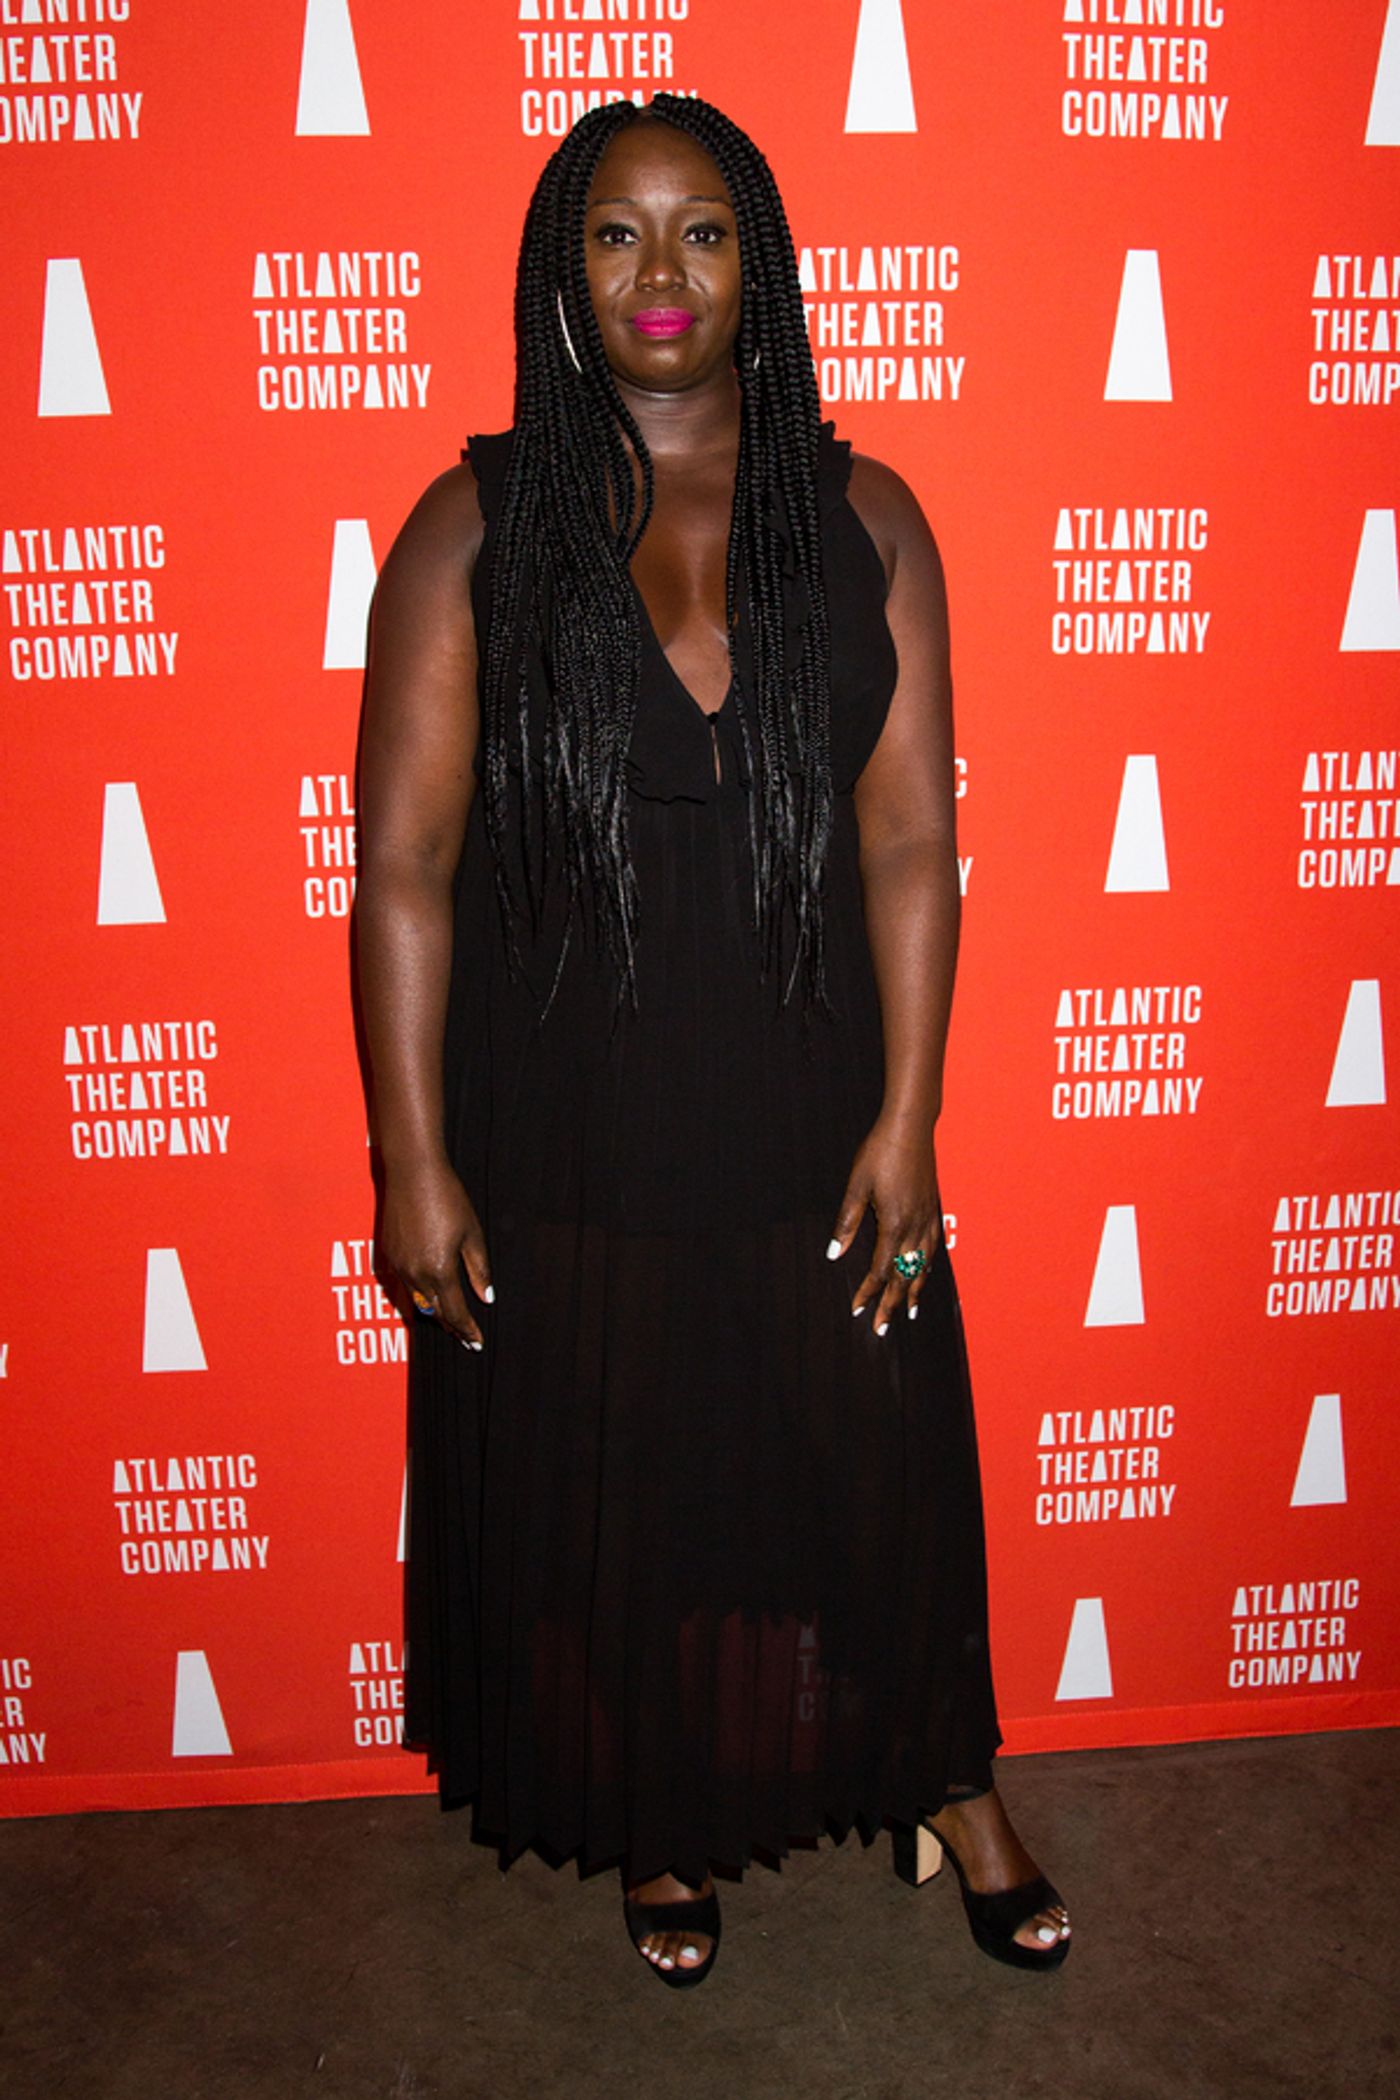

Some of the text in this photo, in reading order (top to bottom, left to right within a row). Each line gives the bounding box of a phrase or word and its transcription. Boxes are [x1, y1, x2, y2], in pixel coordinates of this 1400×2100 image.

[0, 34, 117, 84] EATER
[518, 31, 674, 79] THEATER
[1062, 32, 1208, 84] THEATER
[1061, 89, 1229, 141] COMPANY
[252, 251, 421, 299] ATLANTIC
[797, 245, 959, 293] ATLANTIC
[252, 307, 408, 355] THEATER
[257, 363, 432, 411] COMPANY
[811, 356, 966, 403] OMPANY
[1308, 361, 1400, 405] COMP
[2, 524, 165, 574] ATLANTIC
[1053, 507, 1208, 551] ATLANTIC
[3, 579, 154, 627] THEATER
[1052, 559, 1192, 603] THEATER
[1051, 611, 1211, 655] COMPANY
[9, 632, 179, 681] COMPANY
[1300, 750, 1400, 793] ATLAN
[303, 876, 357, 918] CO
[1054, 985, 1202, 1028] ATLANTIC
[63, 1020, 218, 1065] ATLANTIC
[1054, 1032, 1186, 1074] THEATER
[65, 1069, 207, 1113] THEATER
[1052, 1076, 1203, 1120] COMPANY
[71, 1115, 230, 1159] COMPANY
[1271, 1233, 1394, 1275] THEATER
[331, 1284, 402, 1322] THE
[1266, 1275, 1400, 1317] COMPANY
[1038, 1404, 1174, 1446] ATLANTIC
[113, 1454, 257, 1493] ATLANTIC
[1037, 1446, 1159, 1486] THEATER
[114, 1496, 247, 1534] THEATER
[1035, 1484, 1176, 1525] COMPANY
[121, 1536, 269, 1574] COMPANY
[1232, 1579, 1359, 1617] ATLANTIC
[1231, 1617, 1345, 1652] THEATER
[349, 1641, 405, 1674] ATL
[1229, 1651, 1361, 1688] COMPANY
